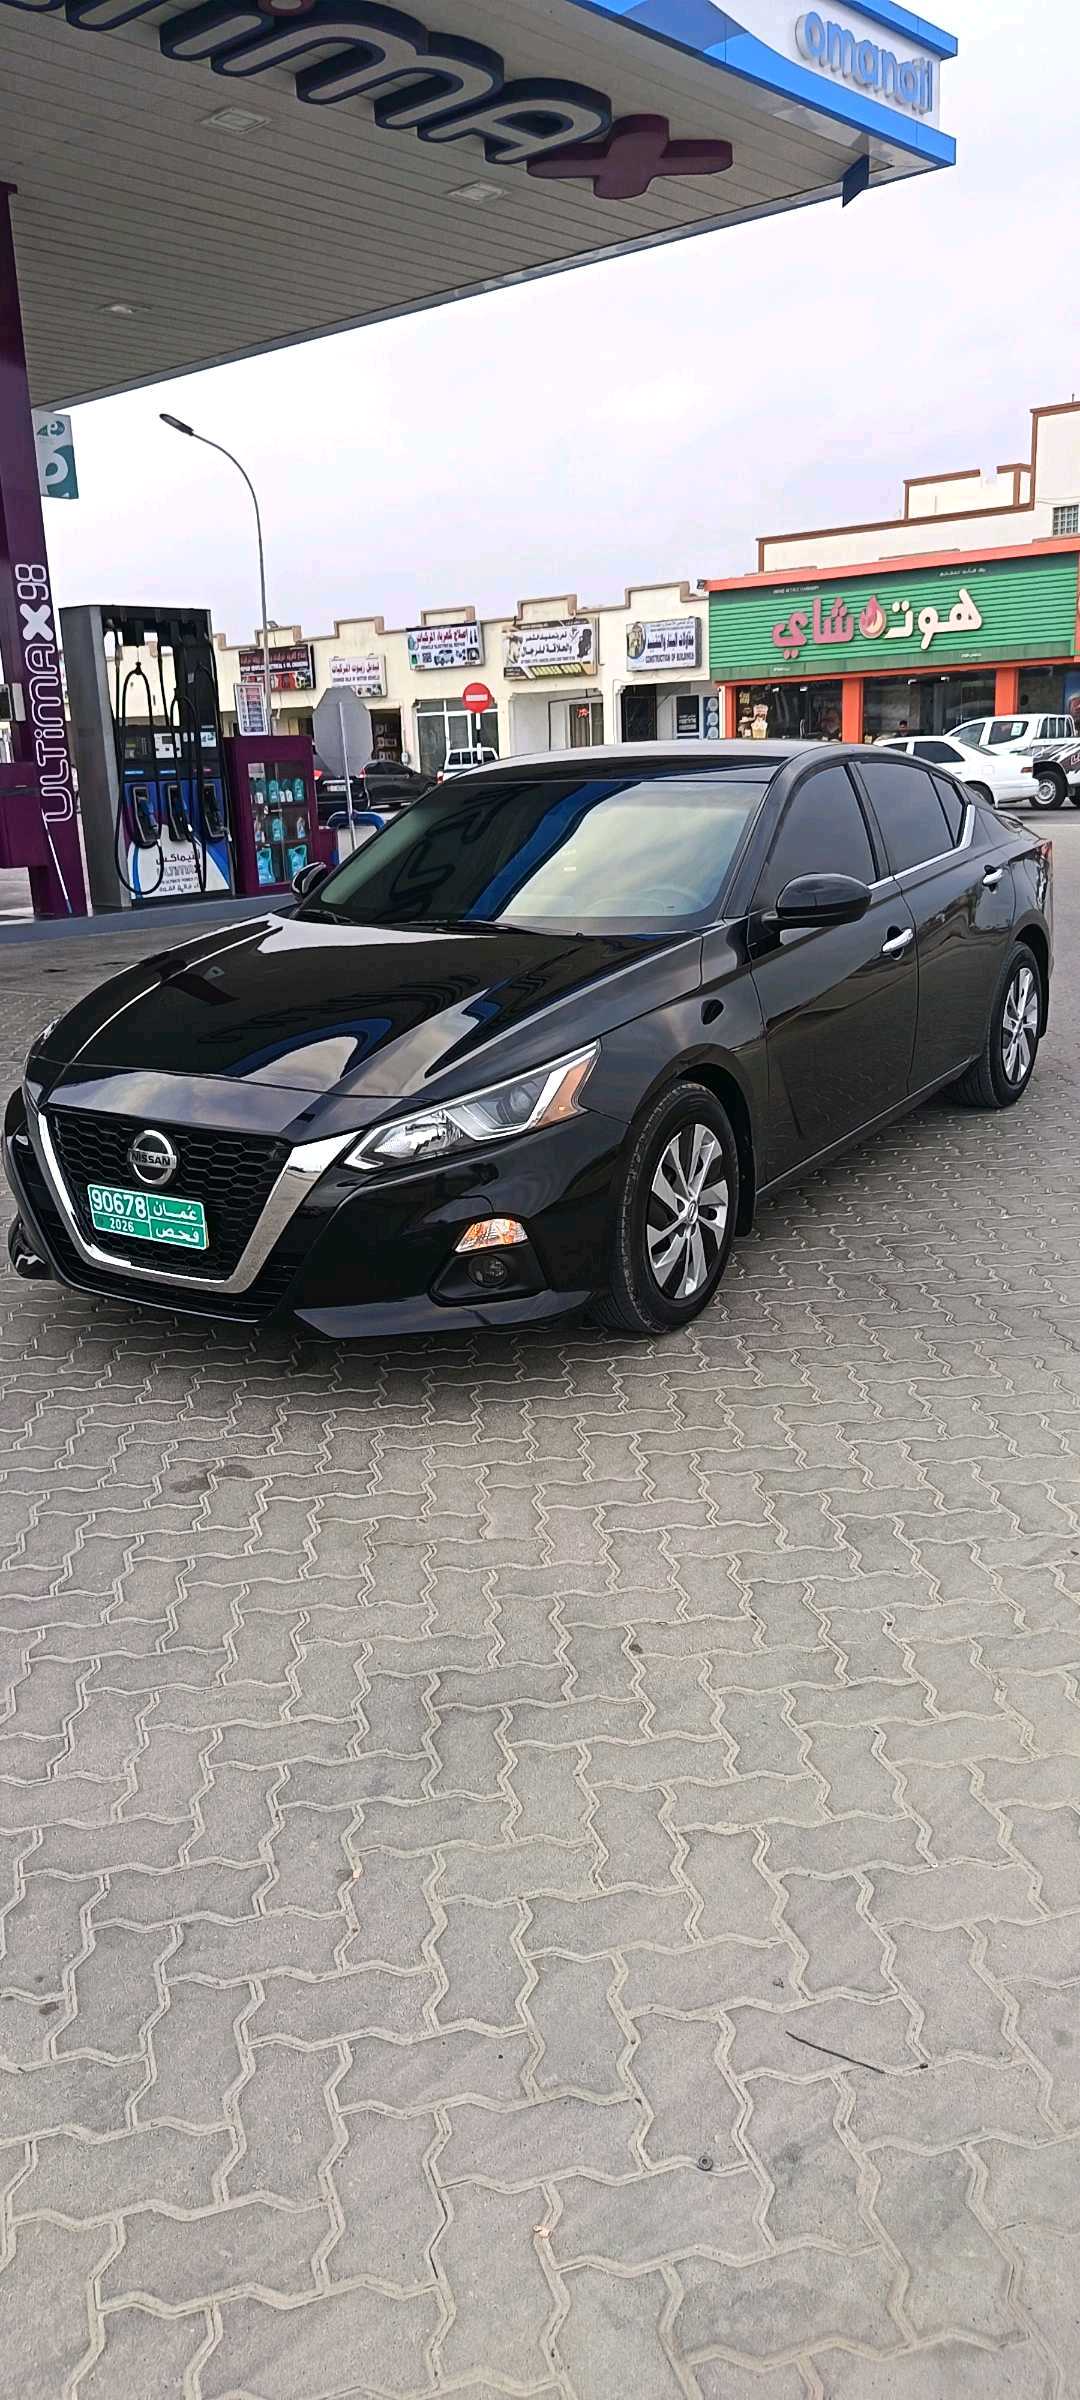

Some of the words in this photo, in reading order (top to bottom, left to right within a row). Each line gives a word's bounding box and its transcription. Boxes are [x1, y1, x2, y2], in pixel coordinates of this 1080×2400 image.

[15, 563, 49, 600] 98
[771, 596, 854, 660] شاي
[884, 588, 983, 650] هوت
[131, 1152, 171, 1166] NISSAN
[91, 1189, 146, 1219] 90678
[109, 1218, 135, 1232] 2026
[156, 1228, 200, 1243] فحص
